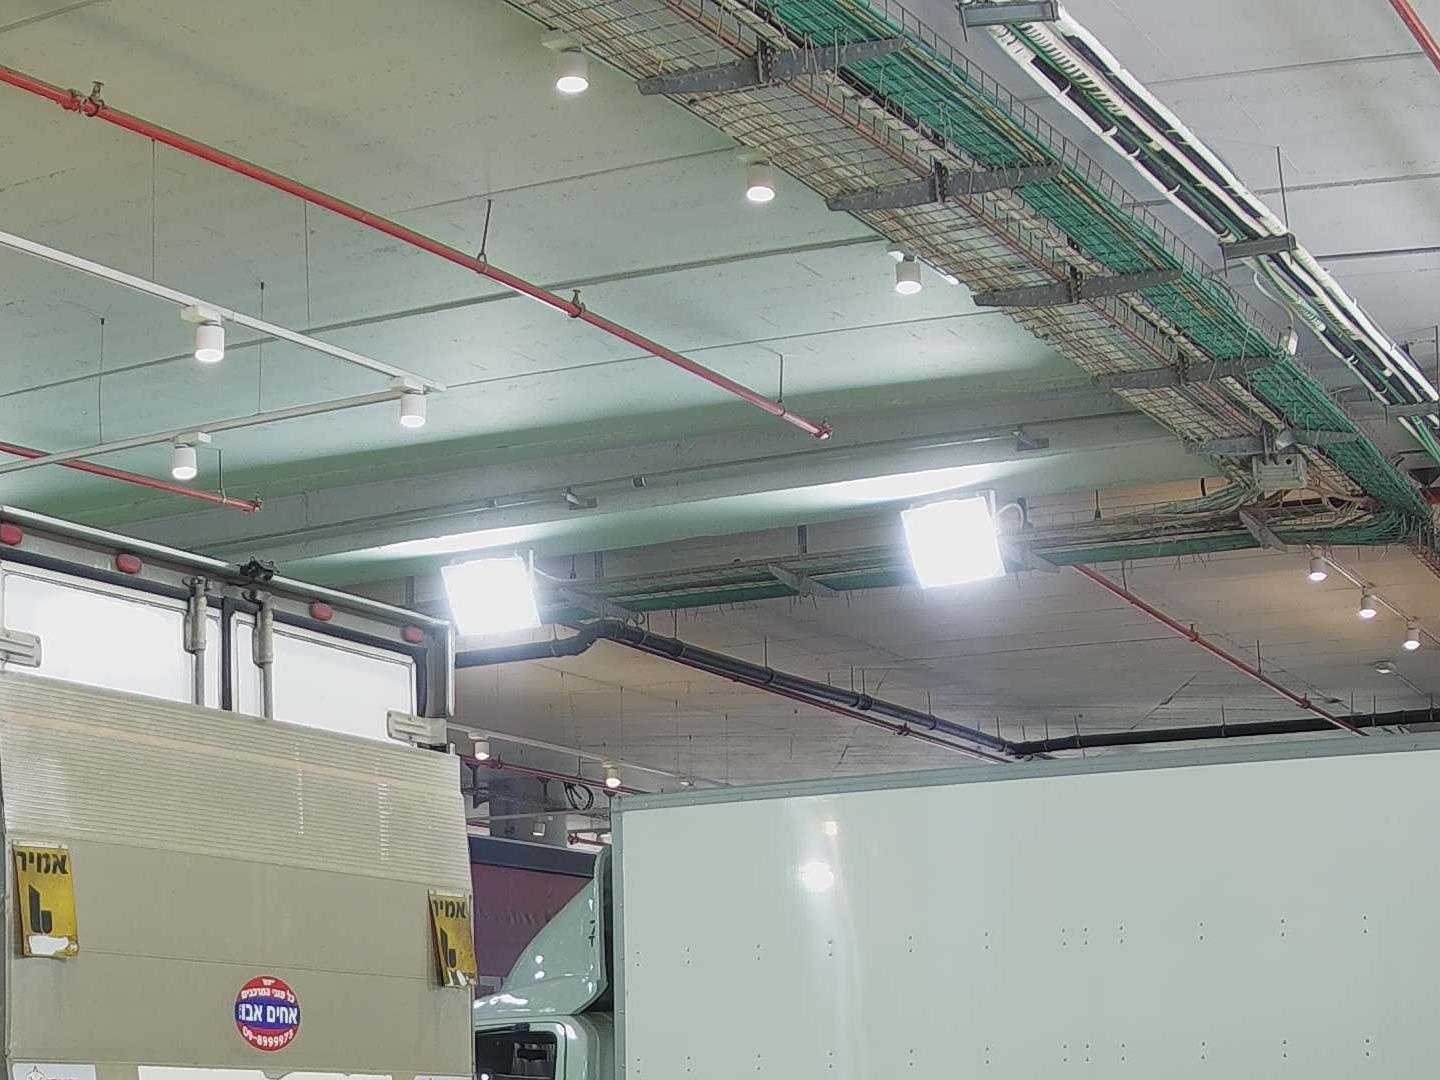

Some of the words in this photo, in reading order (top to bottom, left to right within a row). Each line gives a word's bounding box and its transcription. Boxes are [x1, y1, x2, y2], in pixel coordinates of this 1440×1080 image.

[16, 851, 69, 874] אמיר
[432, 899, 467, 919] אמיר
[266, 1004, 298, 1025] אחים
